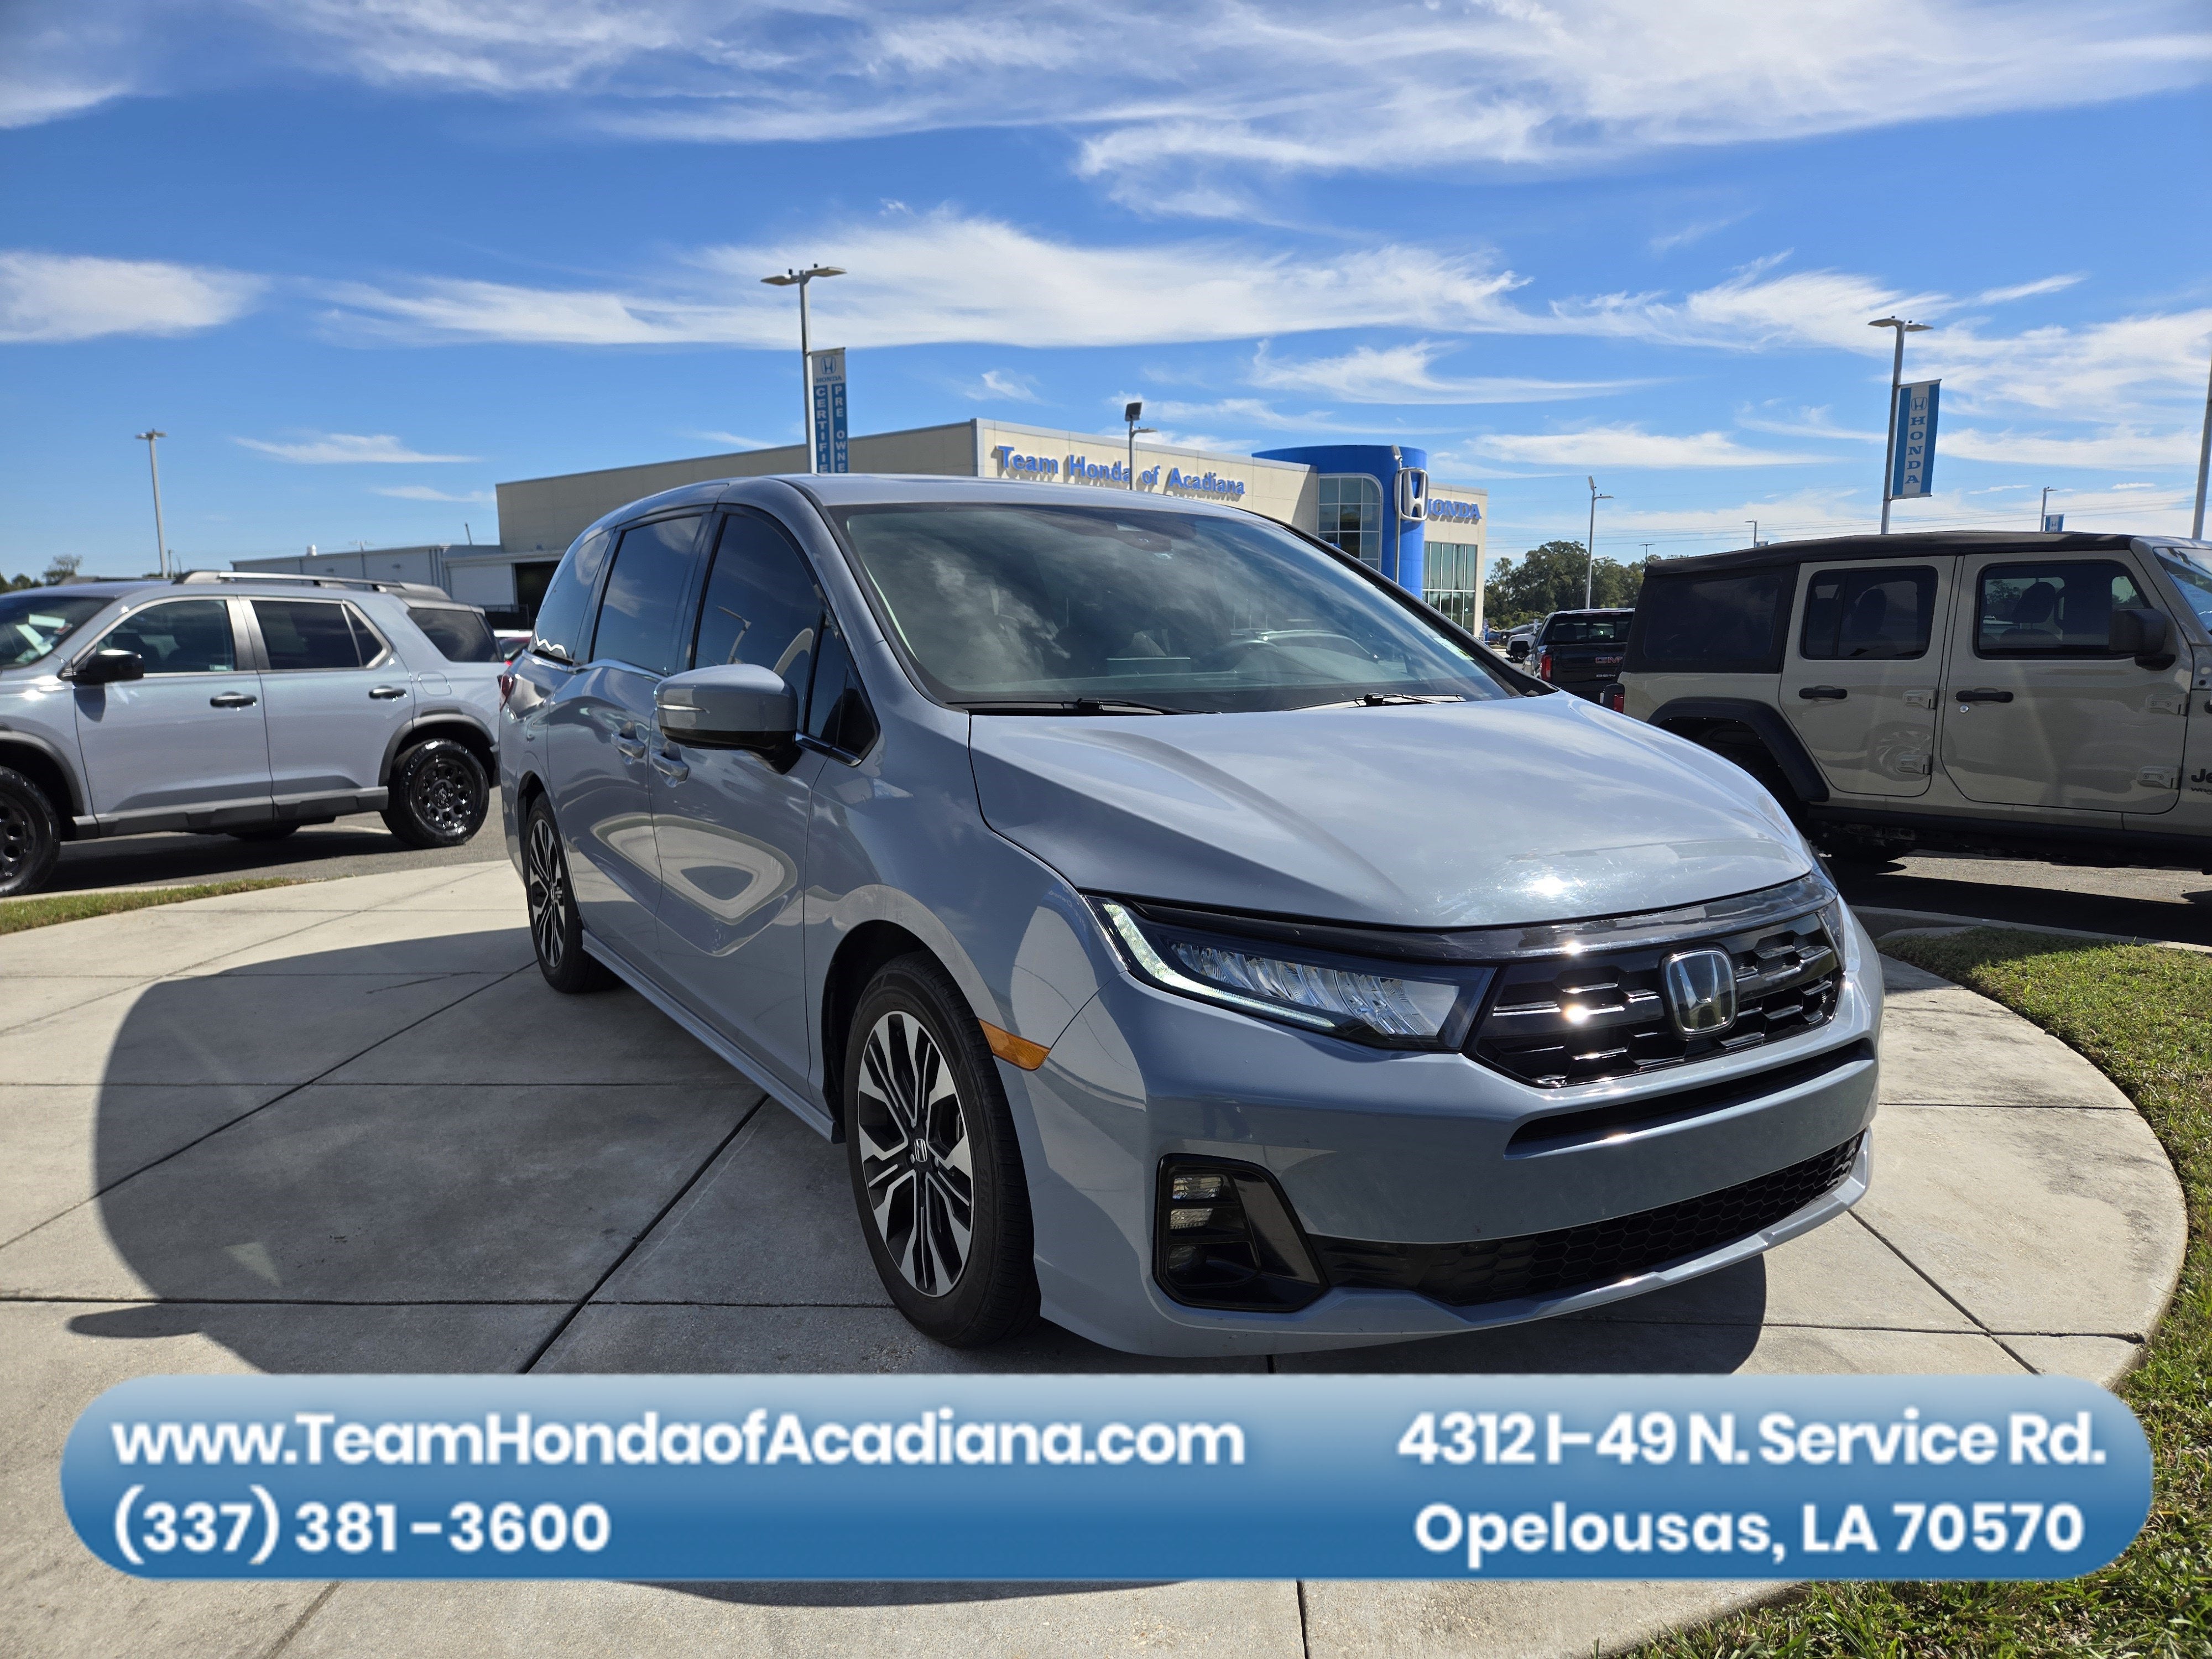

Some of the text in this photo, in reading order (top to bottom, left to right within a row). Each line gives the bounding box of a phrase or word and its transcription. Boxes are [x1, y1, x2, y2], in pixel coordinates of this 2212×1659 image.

[816, 375, 842, 383] HONDA
[834, 386, 844, 418] PRE
[997, 445, 1245, 495] Team Honda of Acadiana
[1905, 416, 1926, 484] HONDA
